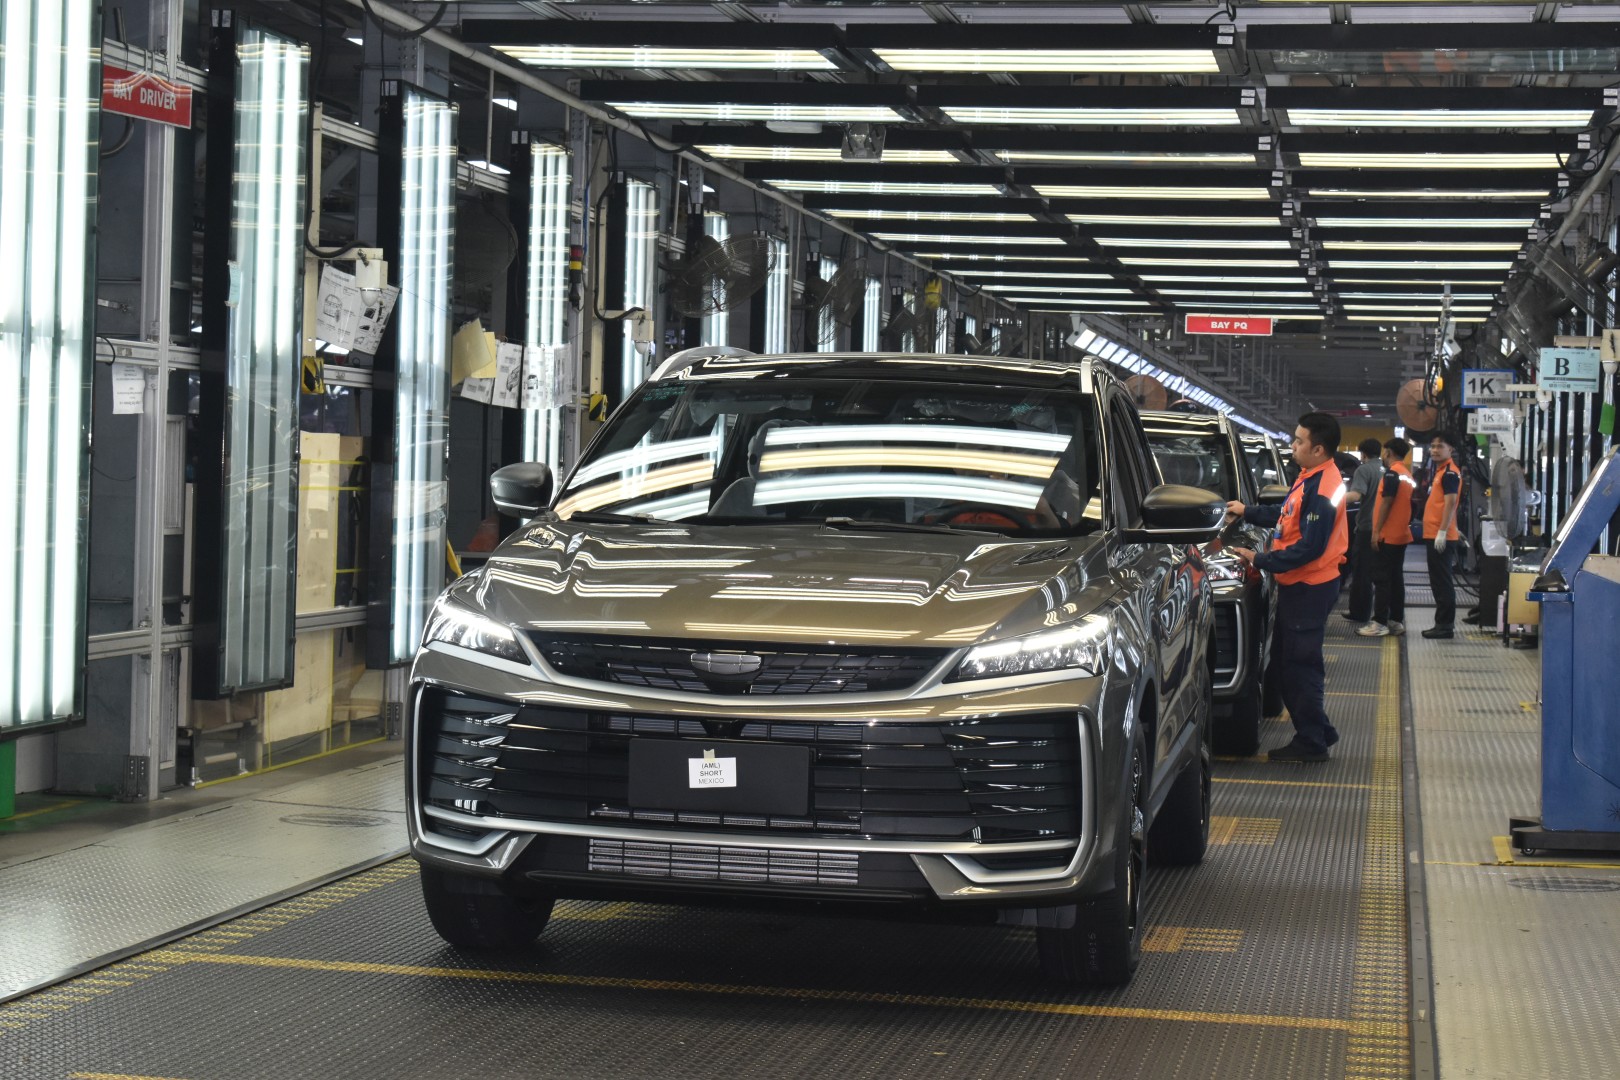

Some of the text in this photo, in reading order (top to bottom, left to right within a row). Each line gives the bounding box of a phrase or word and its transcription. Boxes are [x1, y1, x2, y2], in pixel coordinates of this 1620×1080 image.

[113, 80, 177, 111] BAY DRIVER
[1211, 321, 1248, 330] BAY PQ
[1554, 357, 1570, 376] B
[1468, 377, 1495, 395] 1K
[1483, 413, 1495, 422] 1K
[698, 777, 725, 785] MEXICO
